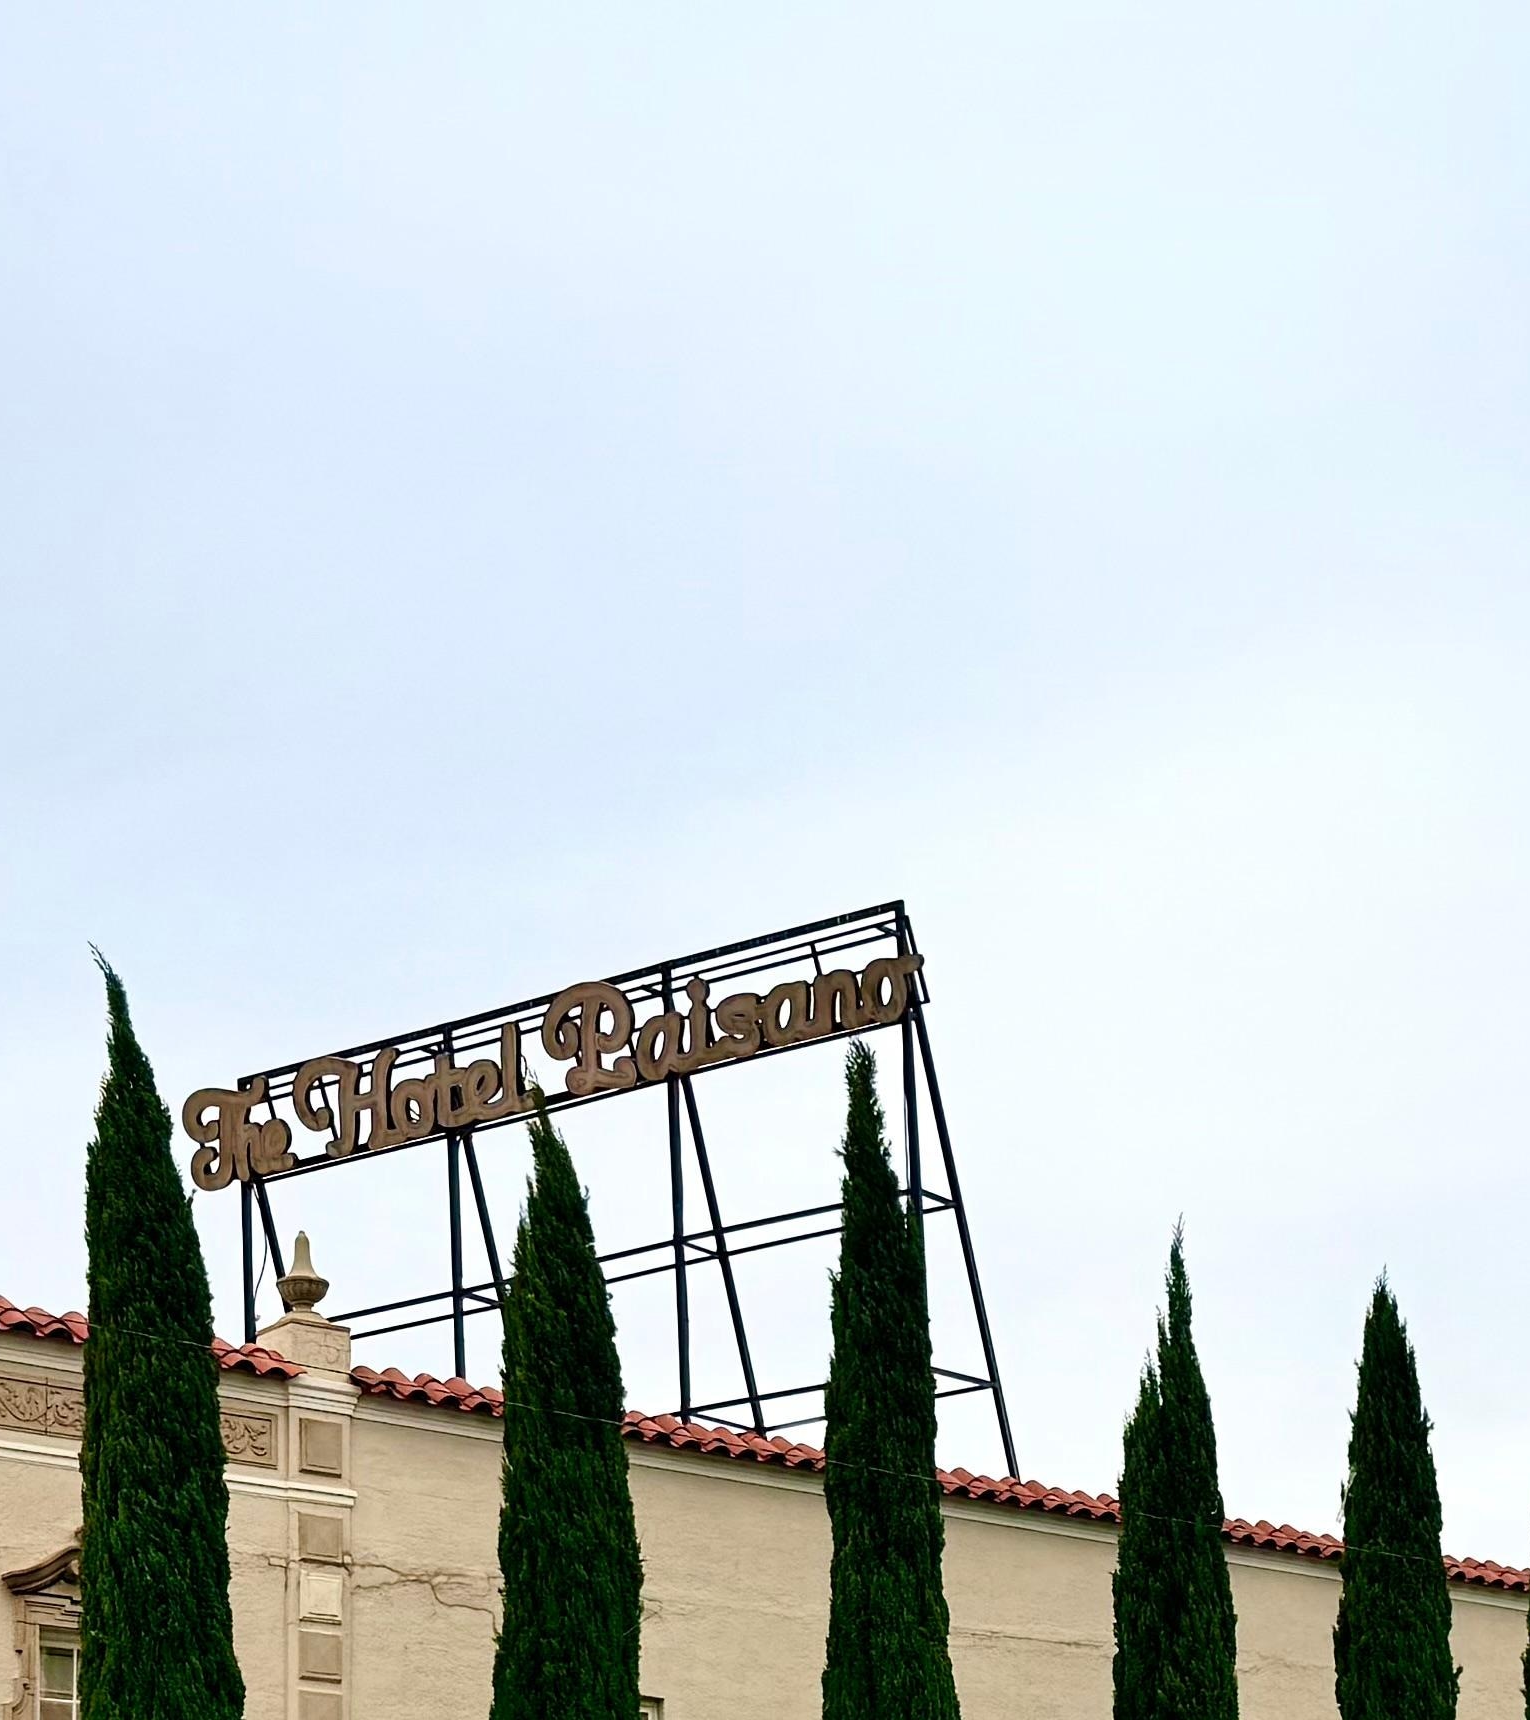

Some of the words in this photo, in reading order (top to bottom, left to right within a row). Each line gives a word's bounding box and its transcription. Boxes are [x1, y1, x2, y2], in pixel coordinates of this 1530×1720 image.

[182, 1074, 296, 1191] The
[293, 1021, 538, 1158] Hotel
[542, 953, 924, 1096] Paisano
